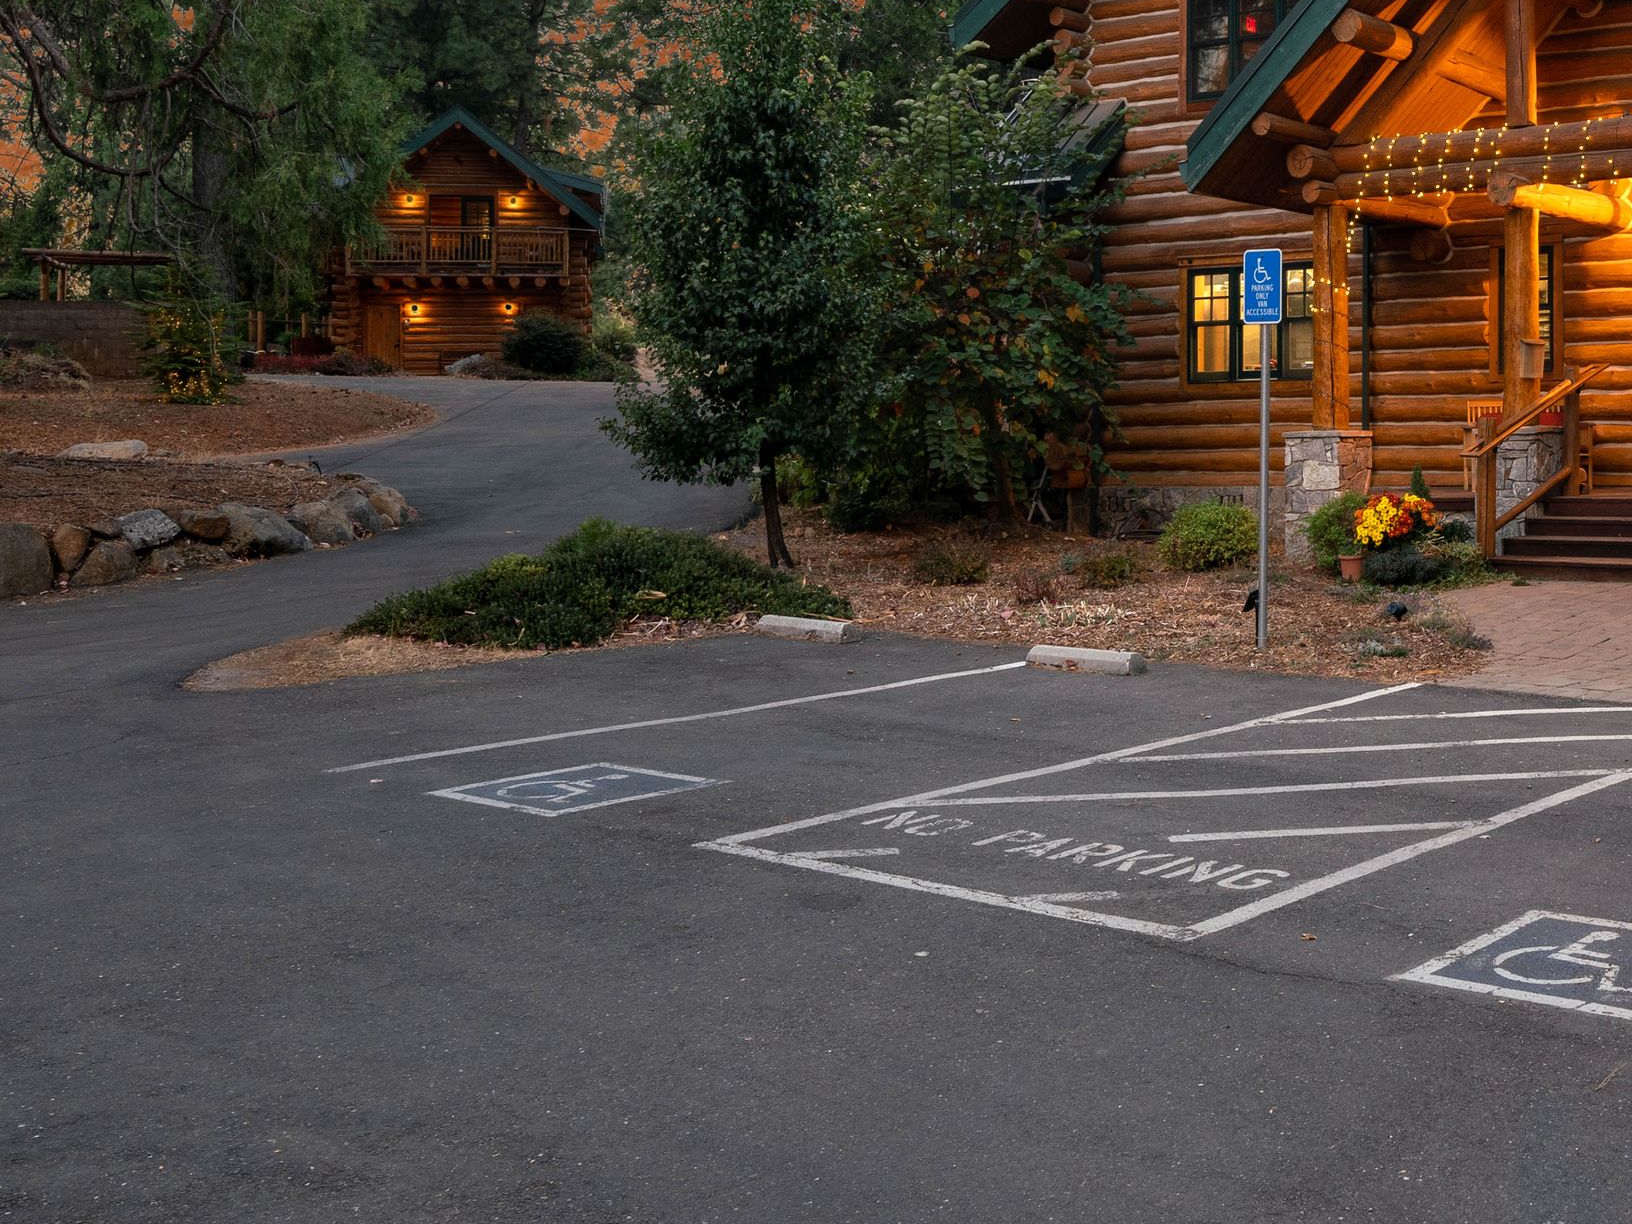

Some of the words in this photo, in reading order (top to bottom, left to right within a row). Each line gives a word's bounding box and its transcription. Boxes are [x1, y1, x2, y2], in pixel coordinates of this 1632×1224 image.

[1251, 284, 1274, 292] PARKING
[1255, 292, 1270, 300] ONLY
[1246, 307, 1279, 316] ACCESSIBLE
[860, 810, 974, 836] NO
[971, 829, 1291, 890] PARKING
